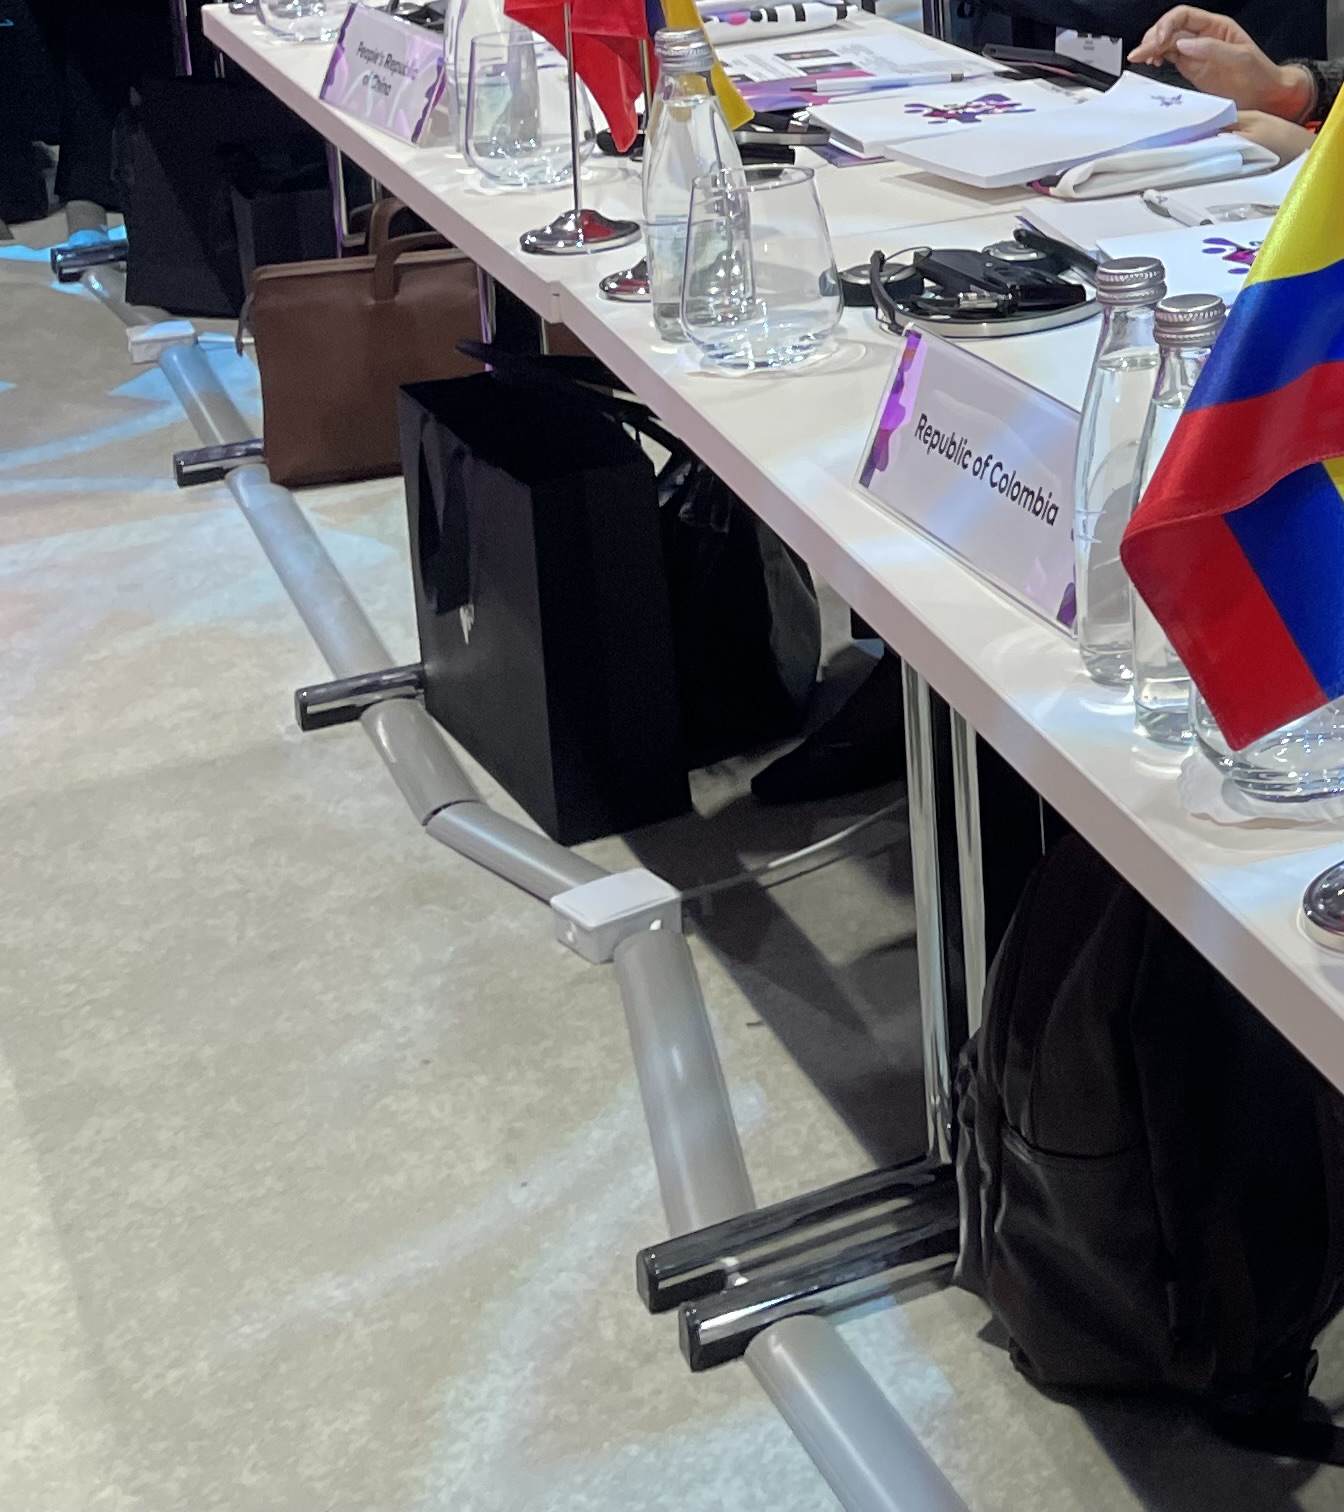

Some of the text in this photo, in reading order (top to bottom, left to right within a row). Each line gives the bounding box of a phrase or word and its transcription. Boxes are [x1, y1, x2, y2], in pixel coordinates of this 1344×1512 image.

[914, 412, 1059, 526] Republic of Colombia
